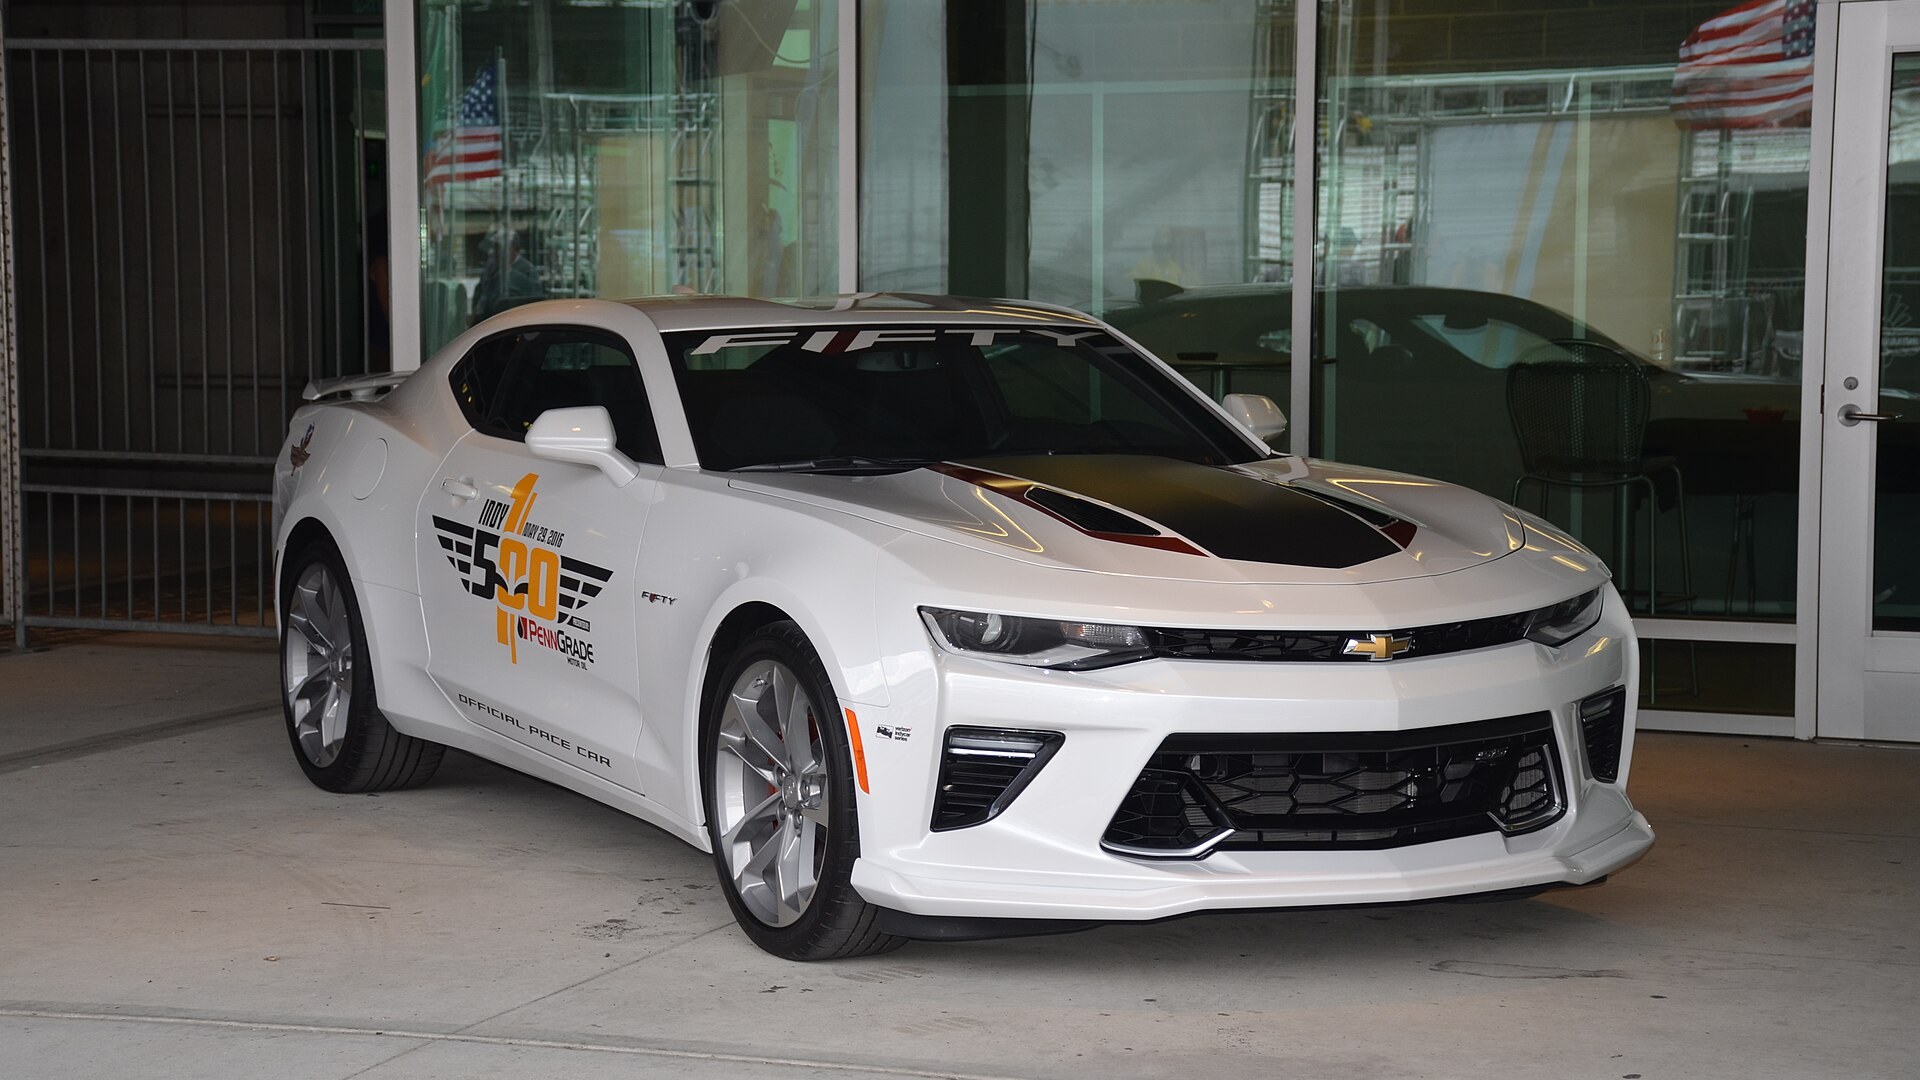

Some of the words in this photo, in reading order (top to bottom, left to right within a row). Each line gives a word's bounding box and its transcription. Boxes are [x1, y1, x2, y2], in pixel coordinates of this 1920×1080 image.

[690, 329, 1105, 354] FIFTY
[478, 499, 510, 530] INDY
[522, 521, 540, 540] MAY
[546, 529, 565, 548] 2016
[471, 528, 559, 621] 500
[458, 693, 525, 730] OFFICIAL
[529, 724, 571, 751] PACE
[576, 745, 612, 769] CAR
